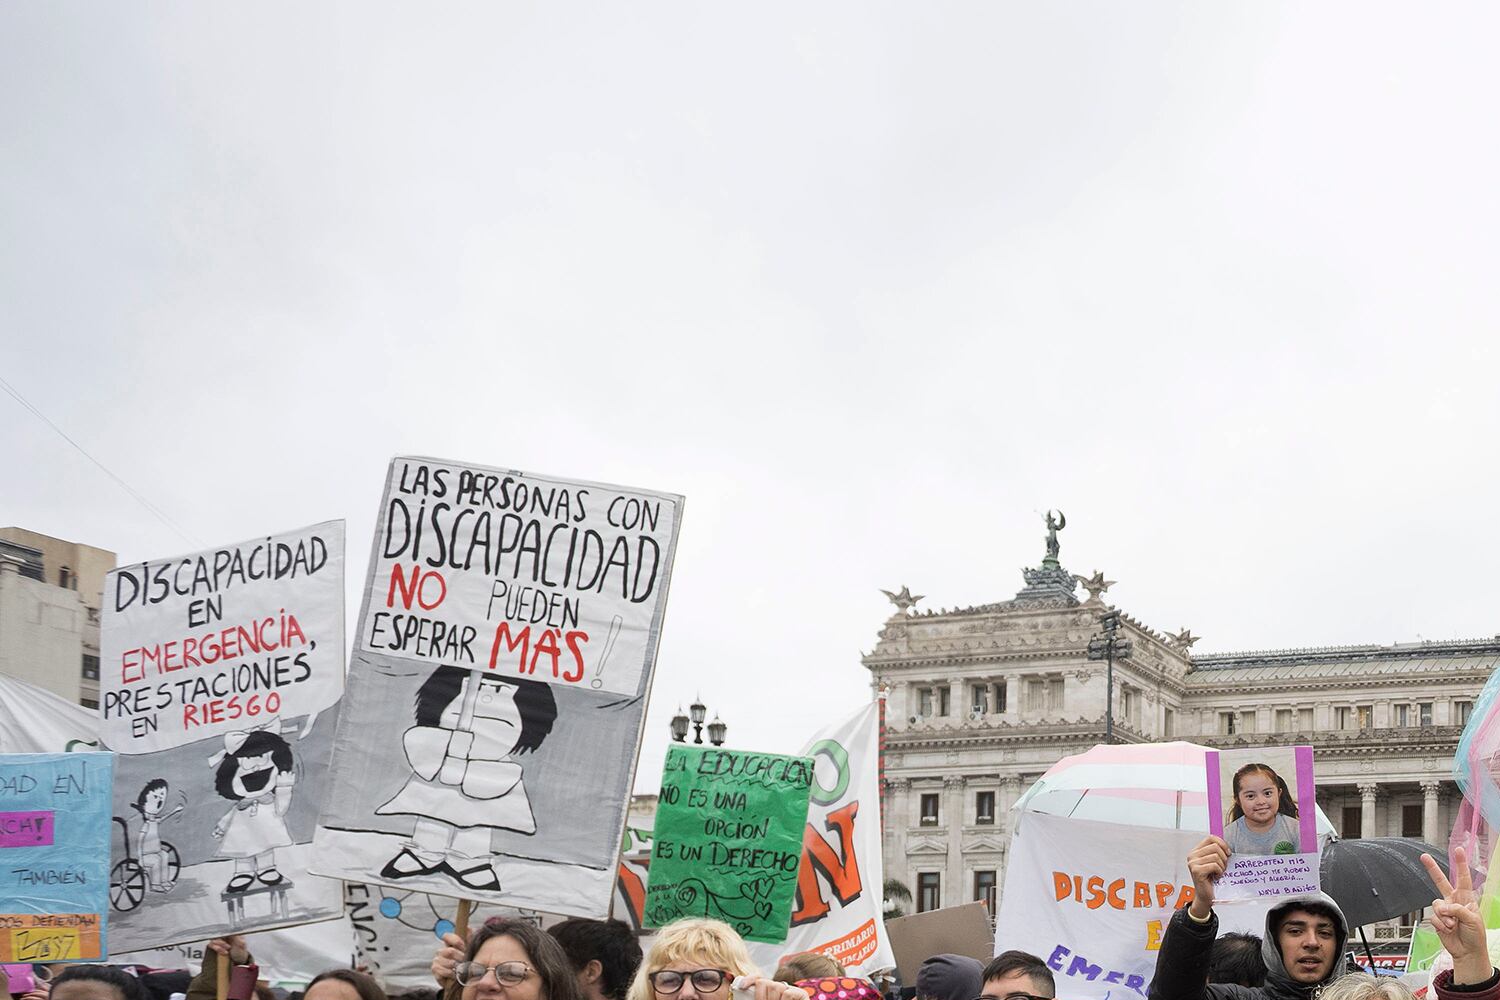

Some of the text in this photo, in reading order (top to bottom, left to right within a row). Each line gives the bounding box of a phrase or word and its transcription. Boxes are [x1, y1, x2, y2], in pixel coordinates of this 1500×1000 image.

[400, 464, 660, 532] LAS PERSONAS CON
[383, 497, 661, 604] DISCAPACIDAD
[115, 536, 328, 613] DISCAPACIDAD
[188, 594, 222, 628] EN
[386, 563, 580, 629] NO PUEDEN
[369, 611, 477, 663] ESPERAR
[104, 652, 312, 720] PRESTACIONES
[132, 691, 281, 738] EN RIESGO
[53, 760, 87, 795] EN
[665, 748, 687, 774] LA
[658, 784, 748, 812] NO ES UNA
[704, 814, 769, 840] OPCIÓN
[656, 841, 799, 873] ES UN DERECHO
[1053, 871, 1196, 910] DISCAPA
[823, 924, 875, 956] PRIMARIO
